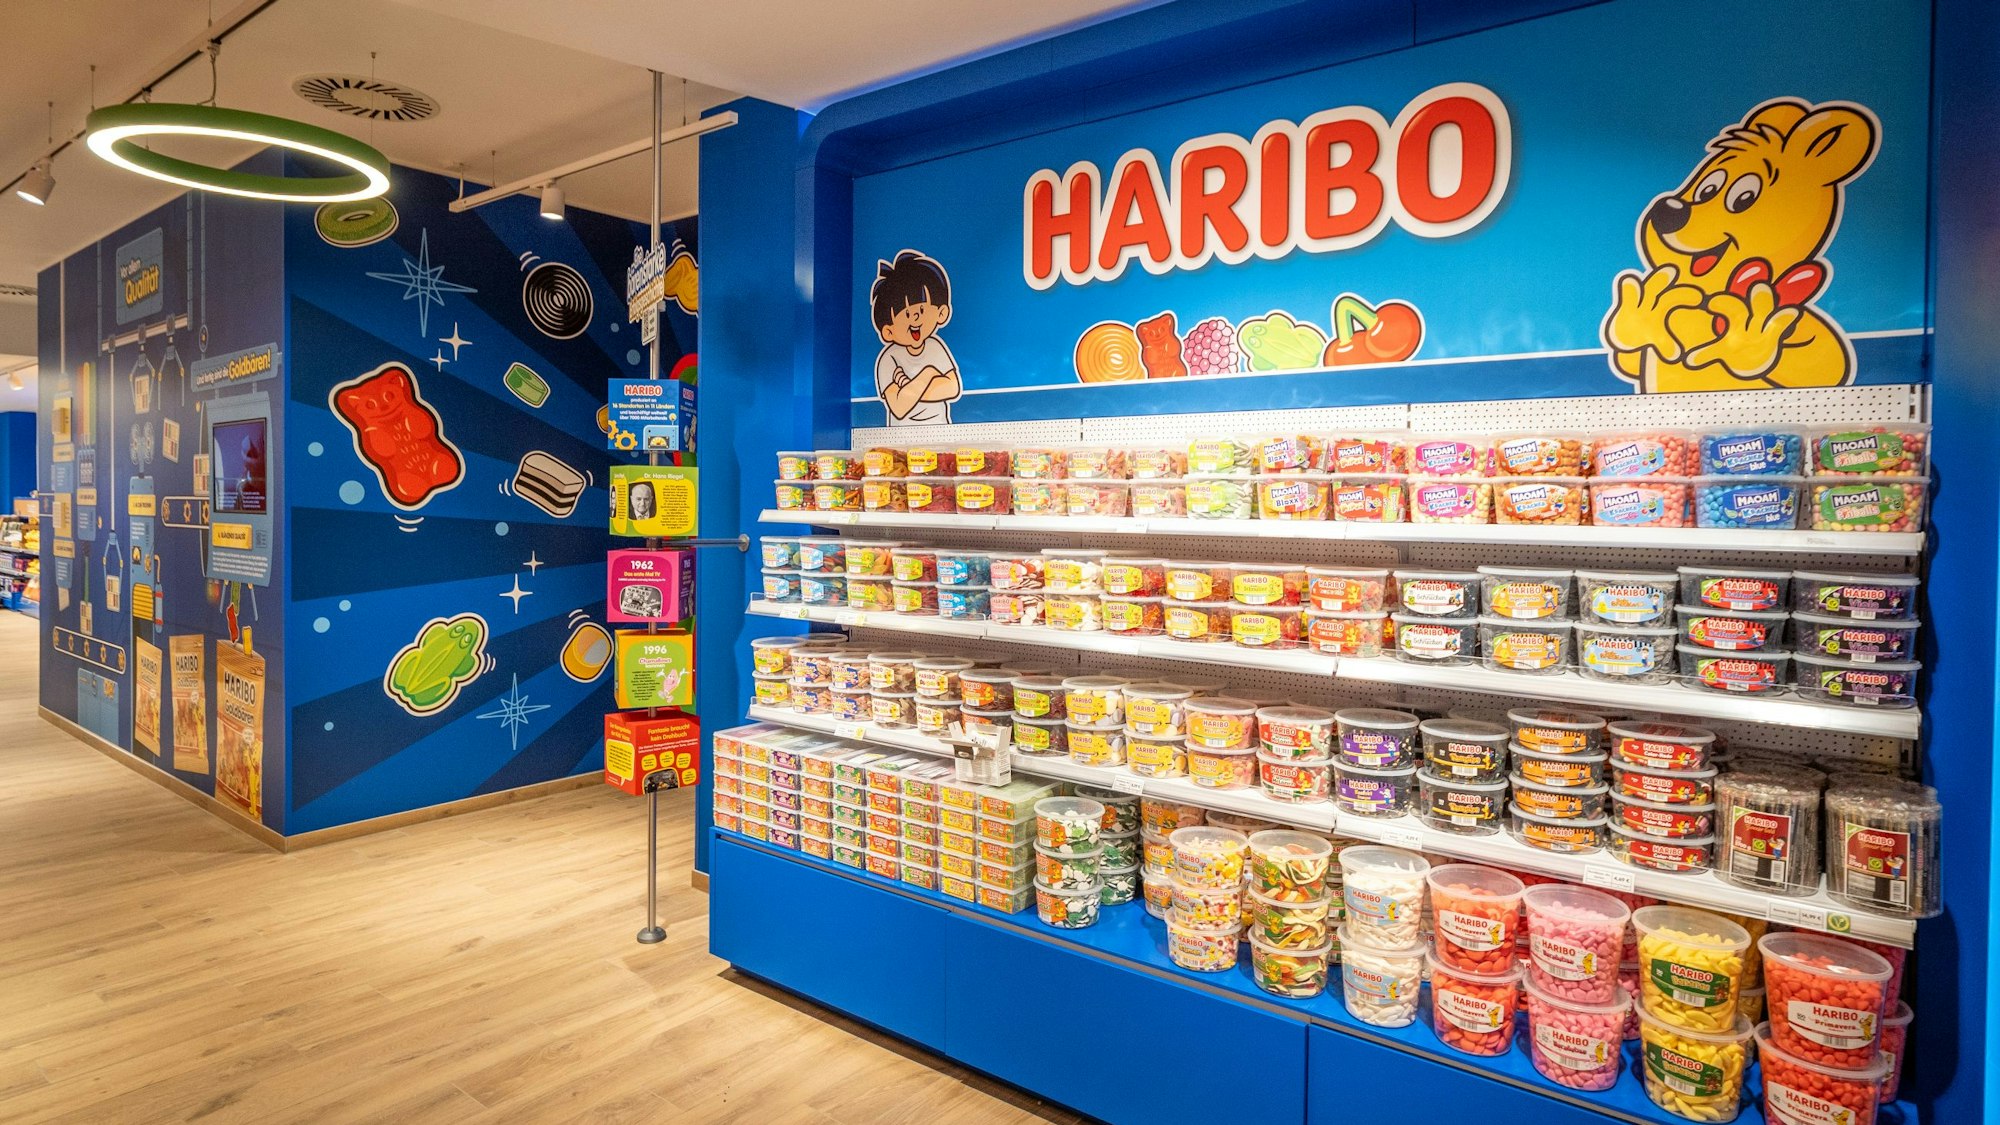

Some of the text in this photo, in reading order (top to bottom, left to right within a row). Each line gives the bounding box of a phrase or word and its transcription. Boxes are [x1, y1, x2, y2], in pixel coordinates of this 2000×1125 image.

[1029, 93, 1500, 280] HARIBO
[125, 266, 160, 306] Qualität
[229, 348, 271, 380] Goldbären!
[625, 386, 662, 396] HARIBO
[1506, 443, 1537, 457] MAOAM
[1720, 440, 1762, 457] MAOAM
[1833, 437, 1876, 454] MAOAM
[1338, 446, 1363, 457] MAOAM
[1425, 446, 1455, 458] MAOAM
[1605, 446, 1636, 464] MAOAM
[1750, 461, 1766, 471] blue
[1273, 486, 1300, 498] MAOAM
[1338, 490, 1363, 502] MAOAM
[1425, 489, 1457, 501] MAOAM
[1512, 489, 1546, 502] MAOAM
[1605, 493, 1639, 507] MAOAM
[1736, 491, 1778, 507] MAOAM
[1834, 491, 1877, 506] MAOAM
[1766, 512, 1780, 523] blue
[631, 561, 653, 570] 1962
[1509, 586, 1541, 594] HARIBO
[1724, 581, 1761, 590] HARIBO
[1610, 588, 1645, 596] HARIBO
[1844, 588, 1885, 599] HARIBO
[1318, 623, 1343, 631] HARIBO
[1707, 620, 1745, 630] HARIBO
[1413, 628, 1443, 636] HARIBO
[1844, 631, 1885, 642] HARIBO
[1511, 637, 1543, 645] HARIBO
[1598, 641, 1634, 649] HARIBO
[644, 645, 667, 654] 1996
[176, 655, 198, 672] HARIBO
[1719, 662, 1757, 672] HARIBO
[1847, 673, 1888, 684] HARIBO
[224, 671, 256, 705] HARIBO
[648, 723, 690, 735] Fantasie braucht
[1203, 720, 1229, 728] HARIBO
[662, 732, 687, 740] Drehbuch
[1270, 726, 1296, 735] HARIBO
[1536, 731, 1563, 739] HARIBO
[1354, 735, 1382, 744] HARIBO
[1449, 744, 1481, 753] HARIBO
[1643, 743, 1674, 753] HARIBO
[1195, 758, 1217, 766] HARIBO
[1271, 767, 1297, 776] HARIBO
[1349, 782, 1377, 790] HARIBO
[1642, 776, 1673, 787] HARIBO
[1448, 794, 1480, 803] HARIBO
[1531, 795, 1558, 803] HARIBO
[1642, 810, 1673, 821] HARIBO
[1745, 816, 1777, 828] HARIBO
[1546, 828, 1574, 837] HARIBO
[1858, 833, 1895, 847] HARIBO
[1652, 845, 1683, 855] HARIBO
[1178, 852, 1200, 864] HARIBO
[1352, 890, 1381, 903] HARIBO
[1454, 915, 1488, 928] HARIBO
[1455, 925, 1486, 936] Primavera
[1178, 936, 1203, 947] HARIBO
[1542, 940, 1576, 956] HARIBO
[1353, 968, 1382, 983] HARIBO
[1670, 964, 1713, 982] HARIBO
[1453, 995, 1487, 1010] HARIBO
[1454, 1006, 1484, 1018] Primavera
[1813, 1006, 1858, 1021] HARIBO
[1815, 1018, 1856, 1030] Primavera
[1552, 1030, 1589, 1047] HARIBO
[1662, 1050, 1702, 1071] HARIBO
[1786, 1090, 1830, 1113] HARIBO
[1788, 1103, 1828, 1121] Primavera
